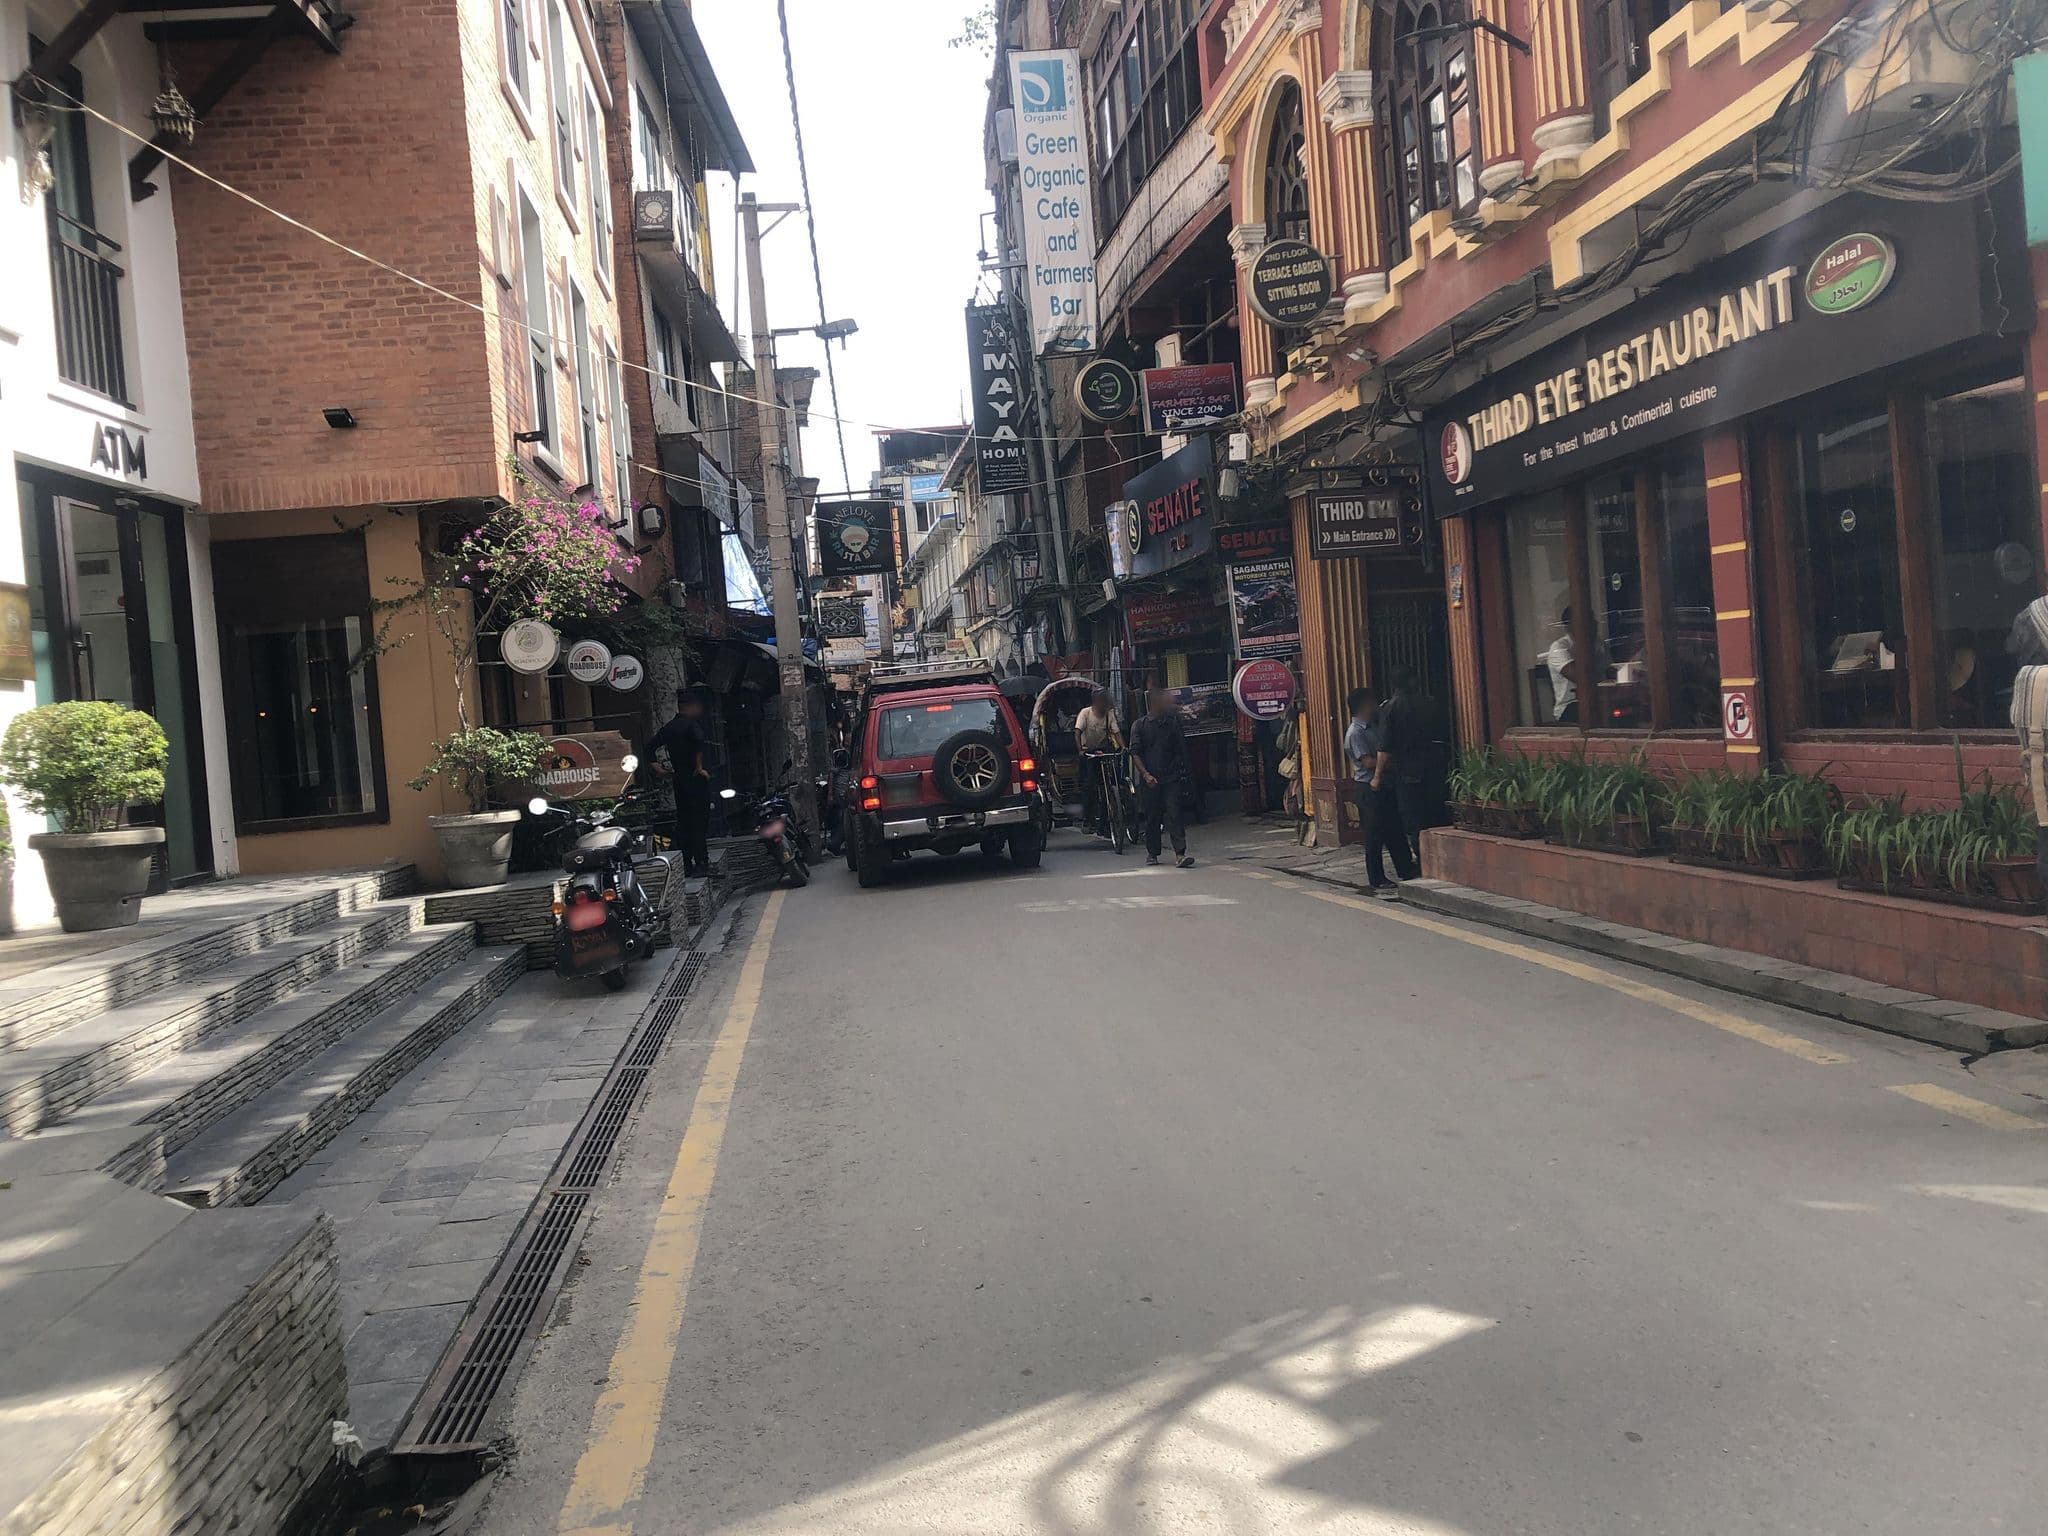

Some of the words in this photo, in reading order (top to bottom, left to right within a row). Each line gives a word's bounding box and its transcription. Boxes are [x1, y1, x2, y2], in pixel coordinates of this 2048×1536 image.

[1023, 112, 1068, 125] Organic
[1025, 132, 1078, 155] Green
[1023, 163, 1085, 192] Organic
[1036, 196, 1080, 220] Café
[1047, 228, 1078, 252] and
[1265, 252, 1281, 263] 2ND
[1282, 247, 1309, 260] FLOOR
[1826, 243, 1862, 270] Halal
[1035, 264, 1094, 286] Farmers
[1257, 265, 1292, 283] TERRACE
[1292, 259, 1324, 277] GARDEN
[1267, 284, 1298, 302] SITTING
[1298, 280, 1321, 296] ROOM
[1050, 295, 1082, 316] Bar
[1287, 305, 1299, 315] THE
[1468, 392, 1533, 452] THIRD
[1534, 367, 1587, 425] EYE
[1586, 265, 1798, 404] RESTAURANT
[982, 352, 1020, 443] MAYA
[1152, 395, 1205, 410] FARMER'S
[1207, 394, 1232, 405] BAR
[1161, 407, 1195, 418] SINCE
[1197, 404, 1223, 414] 2004
[1523, 452, 1537, 467] For
[1540, 446, 1554, 462] the
[1583, 425, 1609, 446] Indian
[1610, 420, 1619, 436] &
[1621, 397, 1674, 431] Continental
[1679, 384, 1718, 410] cuisine
[90, 421, 147, 481] ATM
[1147, 479, 1202, 536] SENATE
[1320, 501, 1365, 522] THIRD
[1333, 530, 1351, 543] Main
[1351, 530, 1384, 542] Entrance
[1233, 561, 1291, 575] SAGARMATHA
[569, 661, 608, 671] ROADHOUSE
